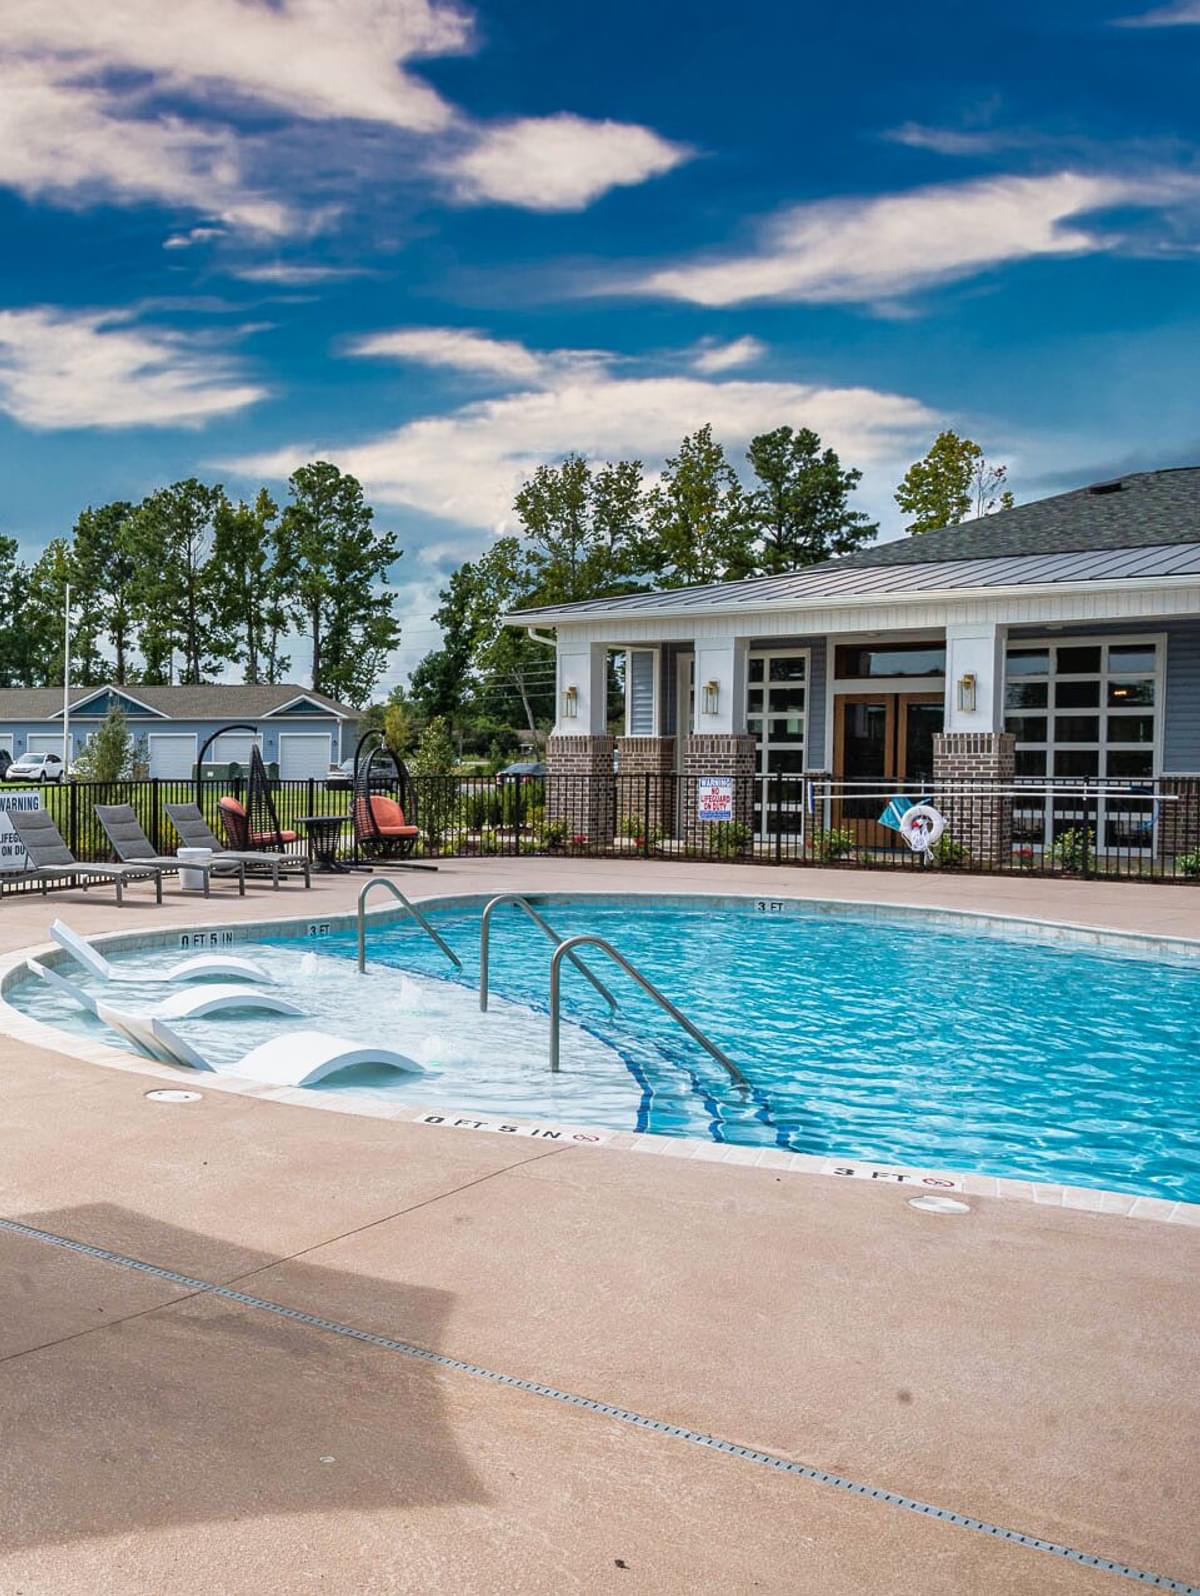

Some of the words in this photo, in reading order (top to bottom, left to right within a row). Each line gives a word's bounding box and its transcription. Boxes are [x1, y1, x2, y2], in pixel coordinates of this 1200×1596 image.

[711, 787, 720, 795] NO
[1, 846, 12, 857] ON
[15, 845, 25, 855] DU
[758, 902, 766, 911] 3
[771, 902, 784, 911] FT
[310, 925, 316, 936] 3
[320, 924, 330, 935] FT
[181, 935, 189, 946] 0
[193, 934, 206, 945] FT
[210, 933, 217, 944] 5
[222, 932, 233, 944] IN
[424, 1116, 445, 1124] 0
[454, 1119, 488, 1128] FT
[498, 1125, 519, 1133] 5
[531, 1129, 561, 1139] IN
[833, 1167, 855, 1176] 3
[872, 1171, 911, 1182] FT
